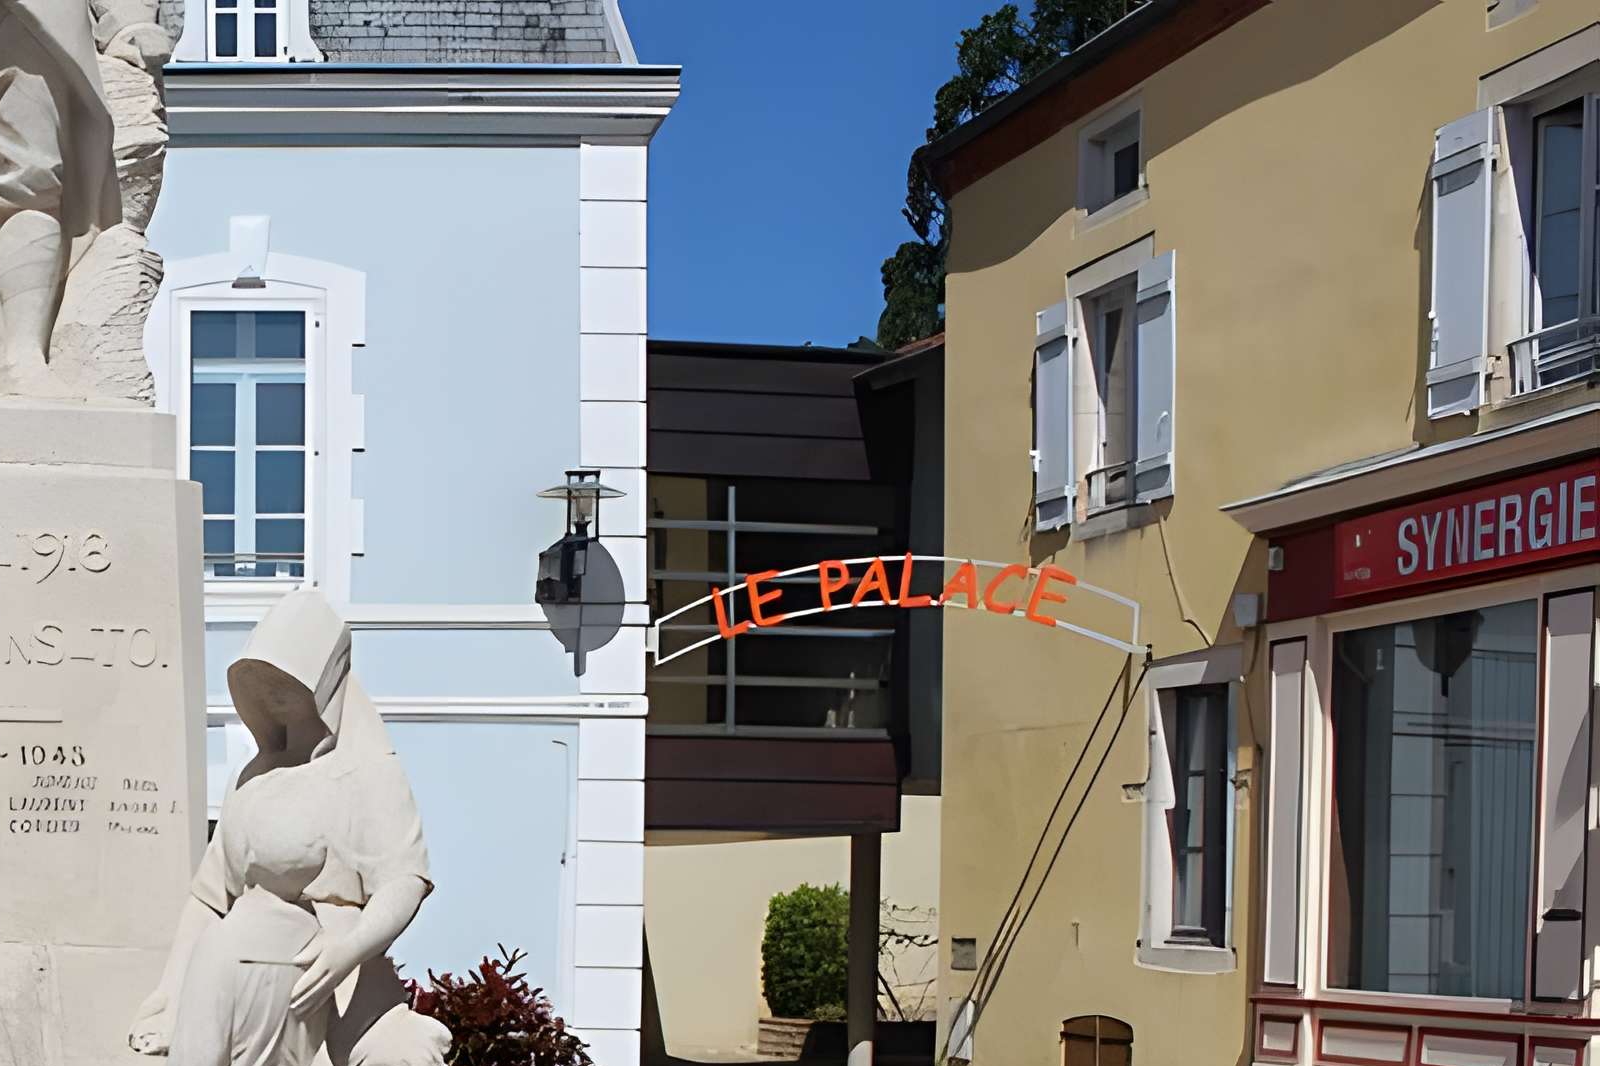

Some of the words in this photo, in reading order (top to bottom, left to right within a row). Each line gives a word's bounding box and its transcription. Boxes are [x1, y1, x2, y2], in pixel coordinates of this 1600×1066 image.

[1396, 475, 1596, 576] SYNERGIE
[712, 569, 787, 640] LE
[818, 551, 1078, 627] PALACE
